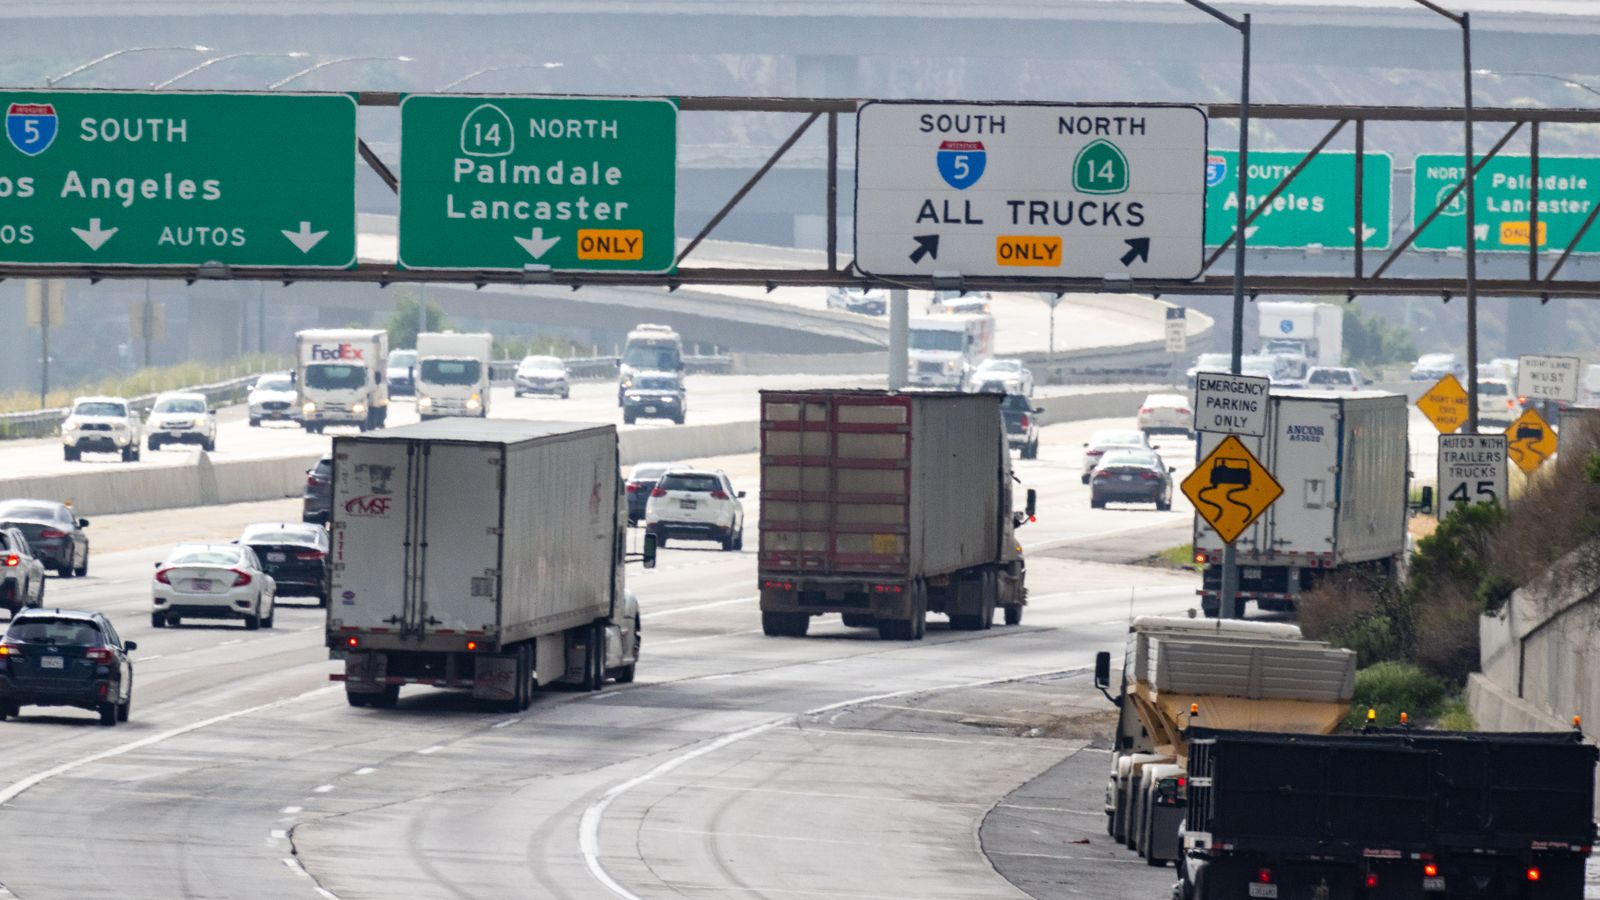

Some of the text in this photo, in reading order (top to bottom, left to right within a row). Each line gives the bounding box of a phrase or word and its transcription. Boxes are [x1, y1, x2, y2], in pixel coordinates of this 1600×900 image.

[25, 119, 39, 143] 5
[80, 117, 187, 142] SOUTH
[474, 123, 501, 147] 14
[529, 118, 618, 139] NORTH
[920, 114, 1146, 136] SOUTH NORTH
[454, 158, 622, 185] Palmdale
[953, 155, 969, 179] 5
[1087, 160, 1115, 184] 14
[60, 170, 222, 208] Angeles
[447, 193, 628, 221] Lancaster
[916, 199, 1146, 227] ALL TRUCKS
[158, 226, 246, 247] AUTOS
[580, 236, 640, 253] ONLY
[1000, 243, 1059, 260] ONLY
[312, 343, 364, 361] FedEx
[1199, 378, 1266, 396] EMERGENCY
[1206, 396, 1258, 413] PARKING
[1214, 414, 1248, 428] ONLY
[1480, 437, 1504, 449] WITH
[1444, 451, 1502, 463] TRAILERS
[1449, 466, 1497, 478] TRUCKS
[1448, 481, 1497, 506] 45
